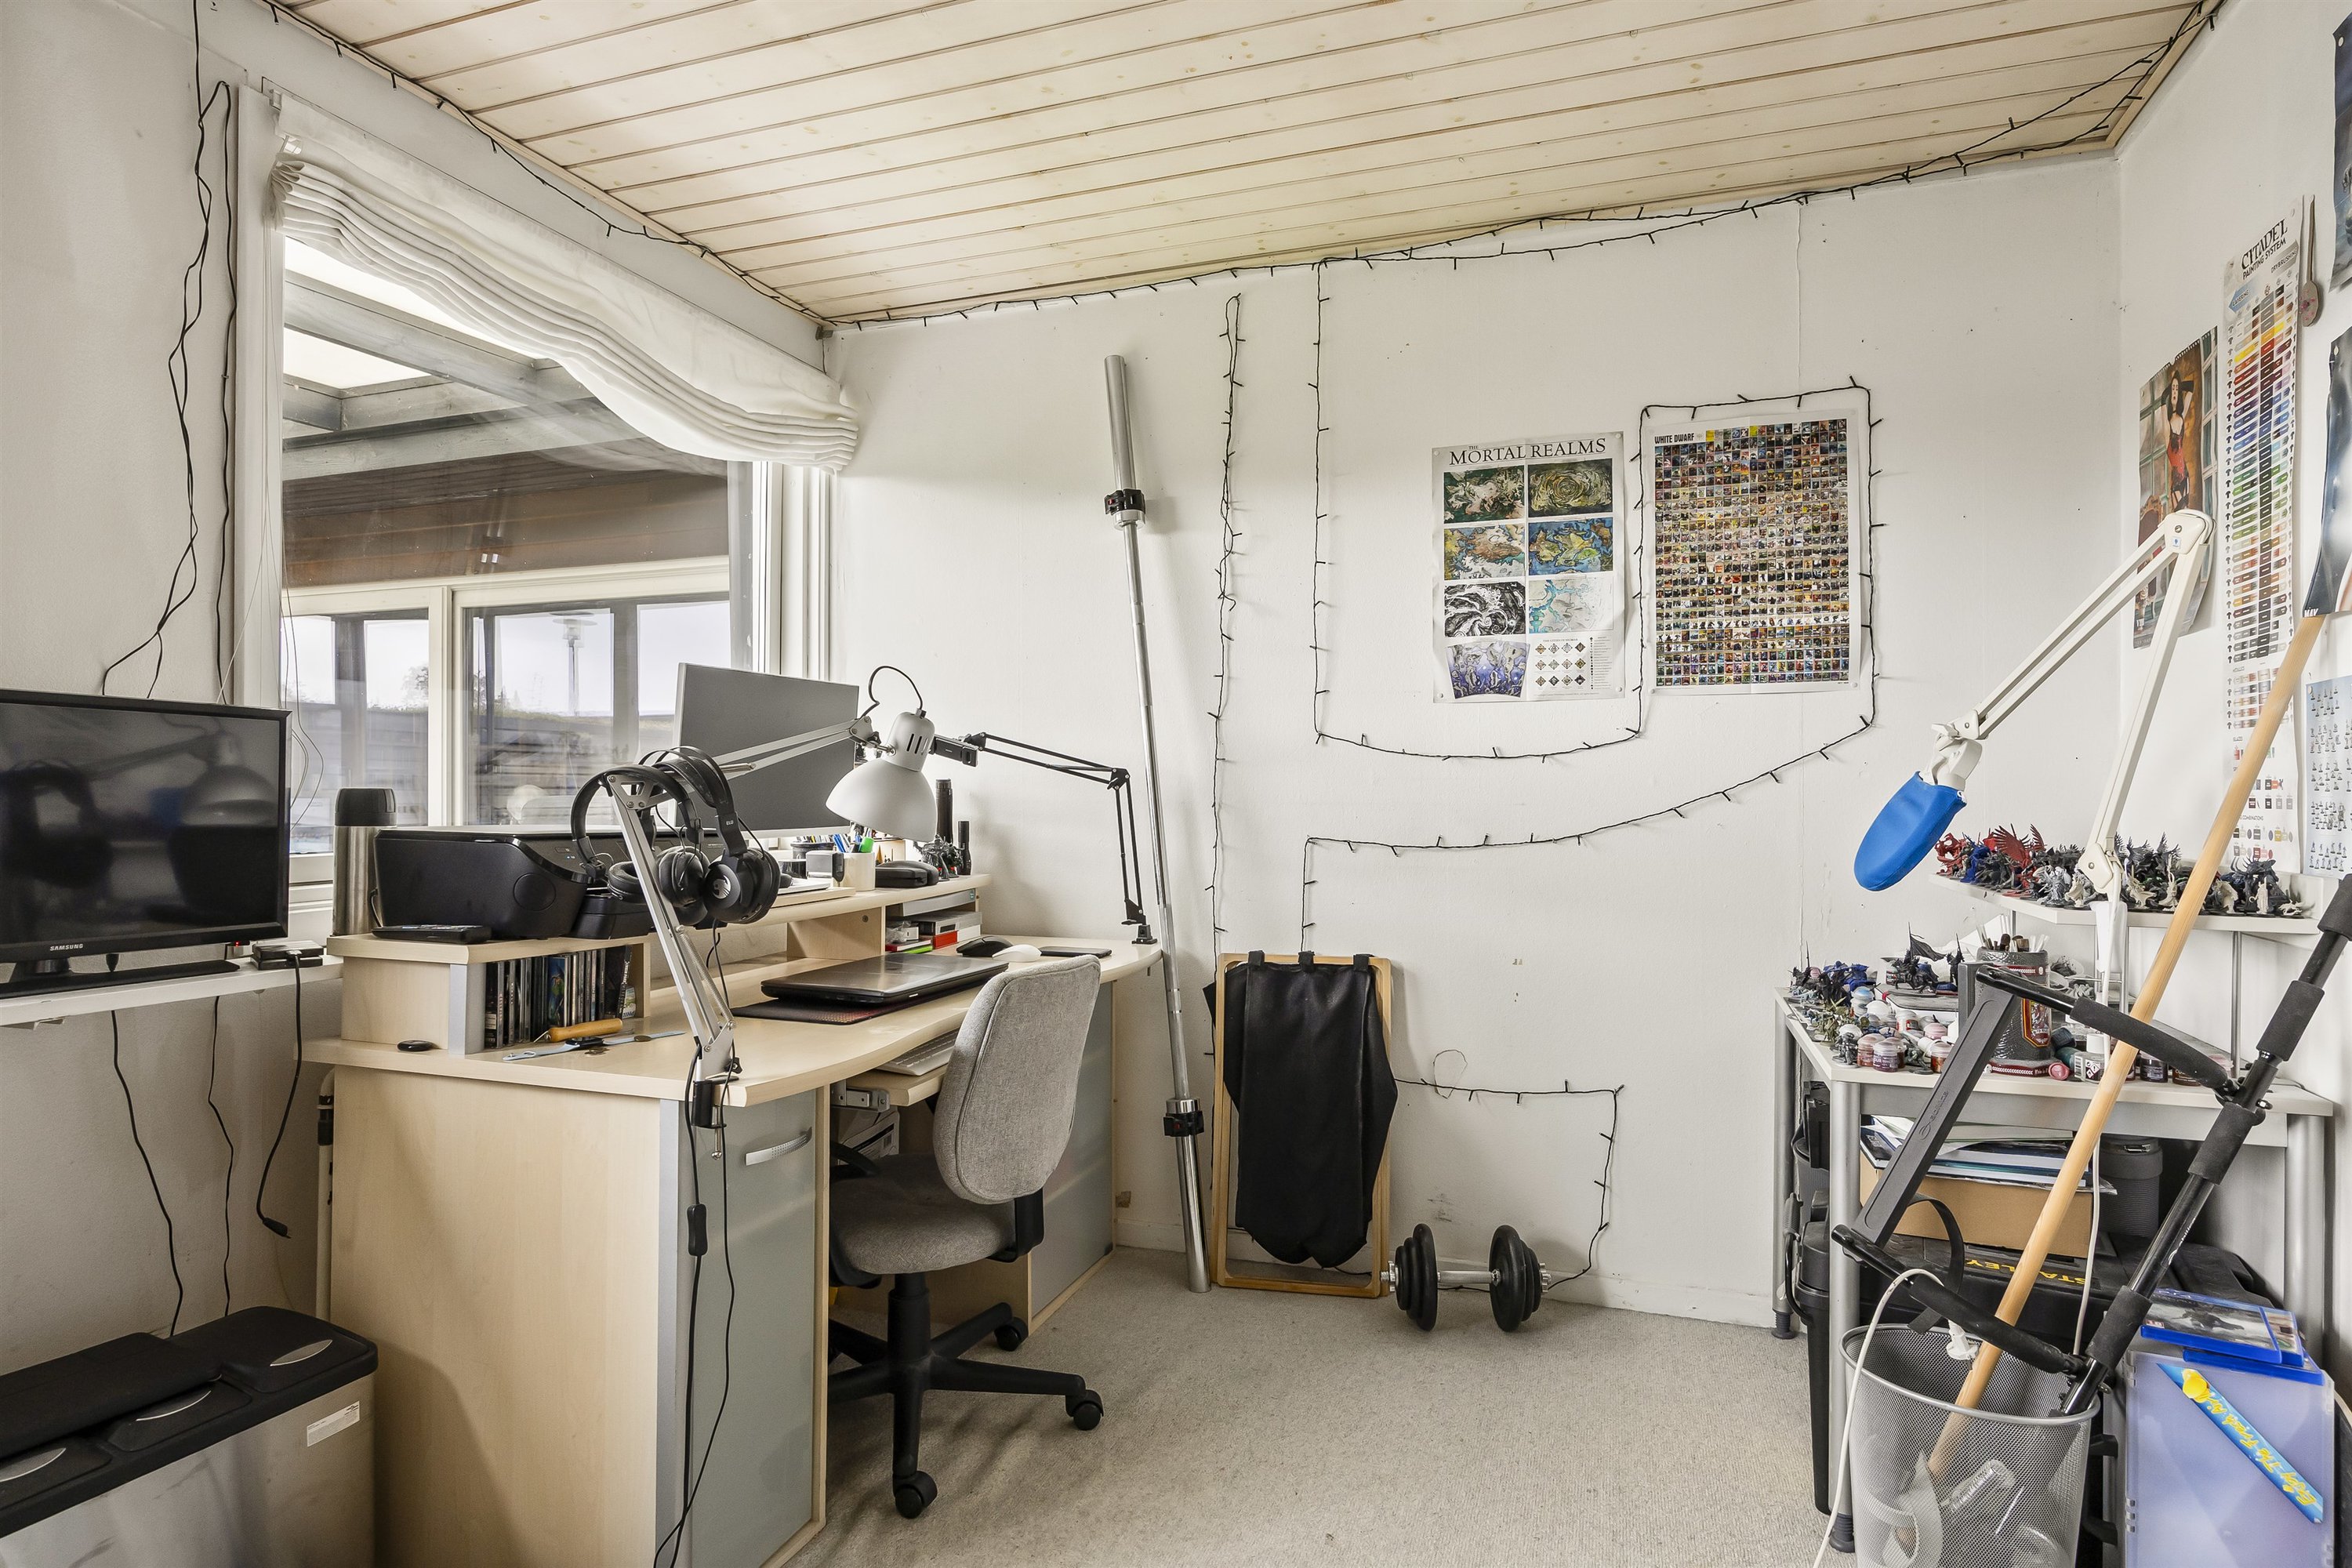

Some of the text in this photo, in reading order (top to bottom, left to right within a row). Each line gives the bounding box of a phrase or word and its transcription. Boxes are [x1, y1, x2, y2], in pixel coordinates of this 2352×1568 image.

[2241, 219, 2288, 270] CITADEL
[2242, 237, 2286, 280] PAINTING SYSTEM
[2270, 248, 2297, 274] DRYBRUSHING
[2232, 289, 2249, 307] LAYERING
[1449, 437, 1606, 466] MORTAL REALMS
[1654, 433, 1695, 444] WHITE DWARF
[1965, 1259, 2085, 1284] STALEY
[2222, 1414, 2259, 1449] Fresh
[2257, 1447, 2281, 1472] The
[2280, 1472, 2317, 1505] Enjoy
